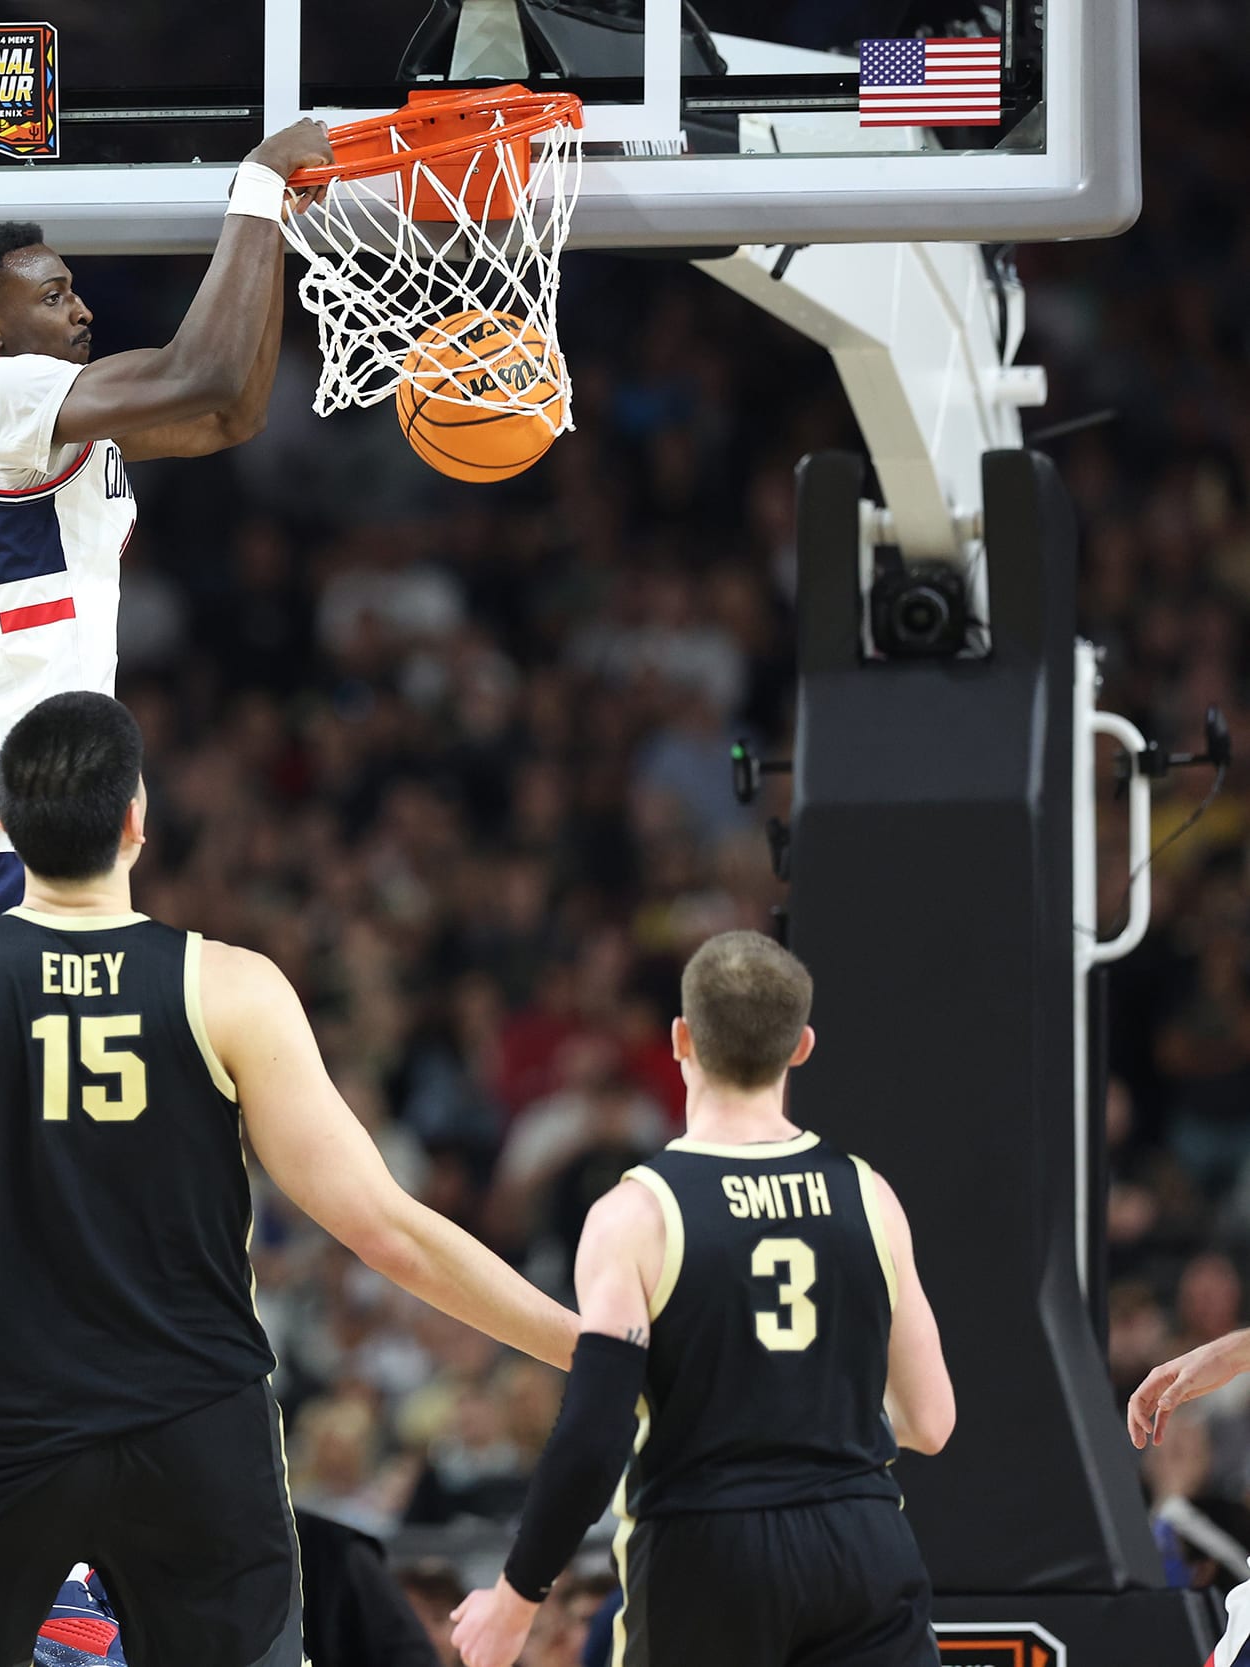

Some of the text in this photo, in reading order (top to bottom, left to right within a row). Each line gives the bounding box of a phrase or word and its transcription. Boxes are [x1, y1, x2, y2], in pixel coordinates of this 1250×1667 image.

[7, 36, 35, 44] MEN'S
[42, 952, 125, 997] EDEY
[31, 1014, 148, 1122] 15
[721, 1171, 832, 1219] SMITH
[751, 1238, 817, 1351] 3
